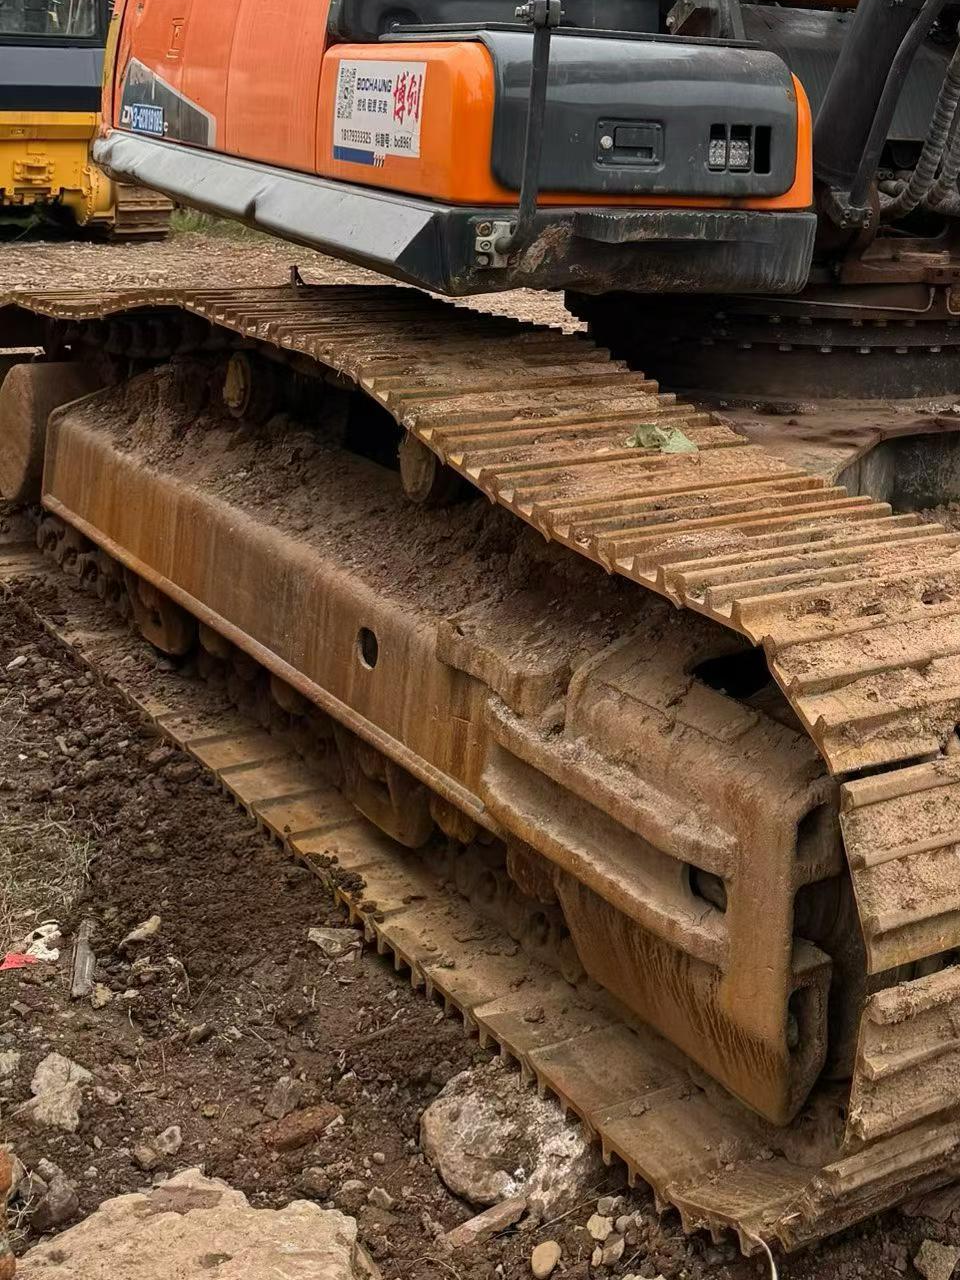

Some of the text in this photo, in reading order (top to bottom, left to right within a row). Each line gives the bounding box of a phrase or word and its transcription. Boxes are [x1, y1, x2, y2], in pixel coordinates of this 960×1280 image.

[357, 78, 392, 92] BOCHAUNG
[367, 98, 377, 113] 租赁
[378, 100, 388, 114] 买卖
